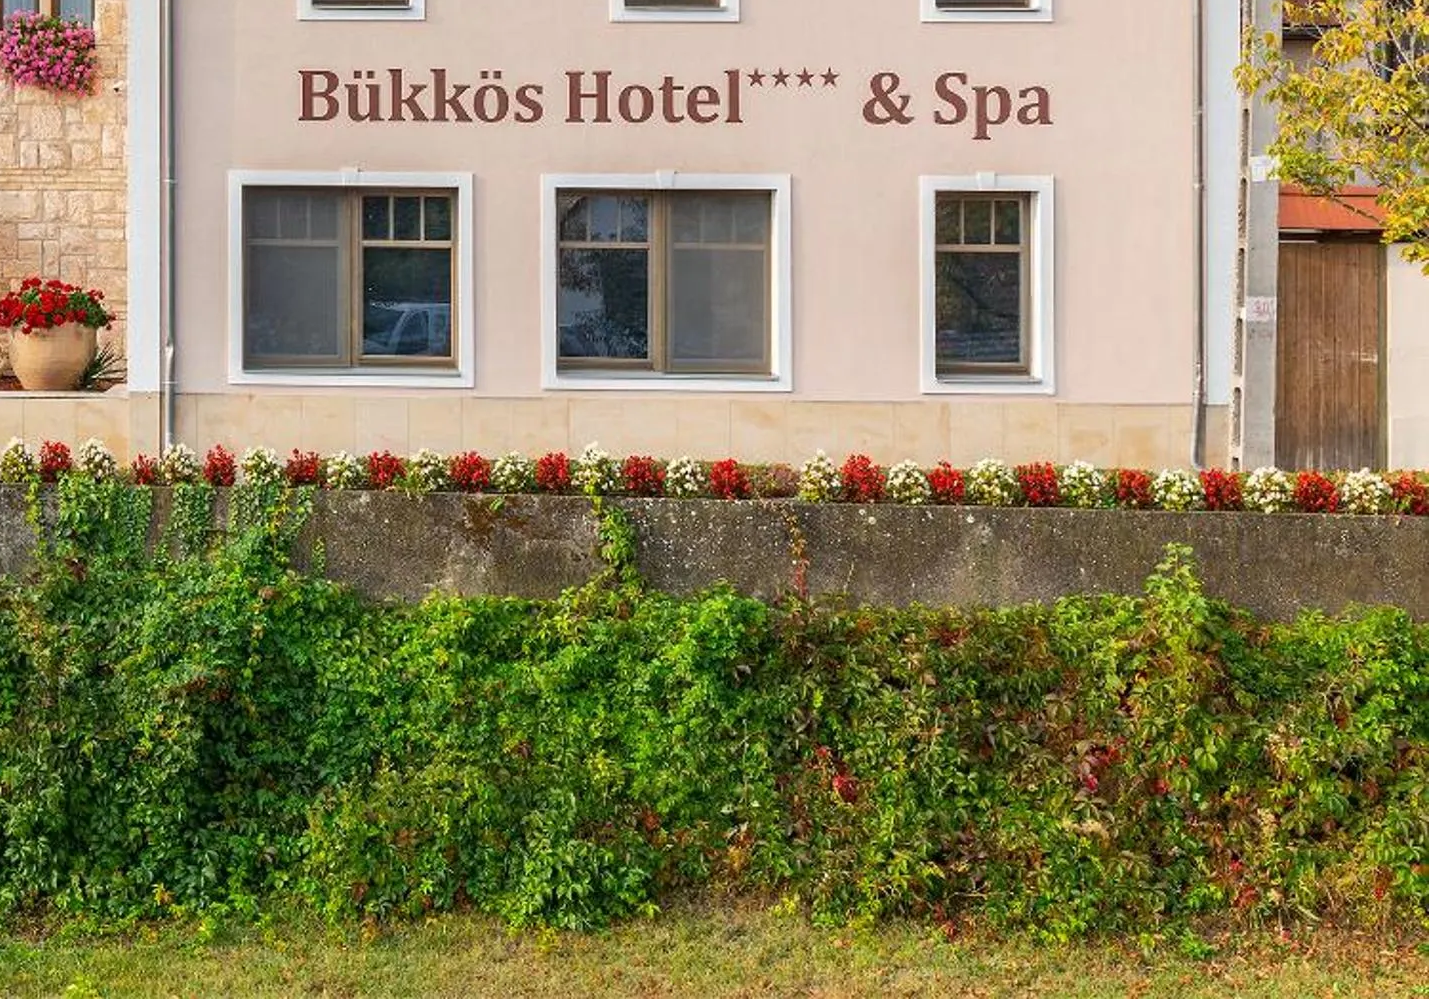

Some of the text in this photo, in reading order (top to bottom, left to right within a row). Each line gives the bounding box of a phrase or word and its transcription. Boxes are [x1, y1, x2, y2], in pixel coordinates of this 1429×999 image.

[296, 67, 544, 124] Bükkös
[862, 71, 916, 125] &
[933, 72, 1055, 140] Spa
